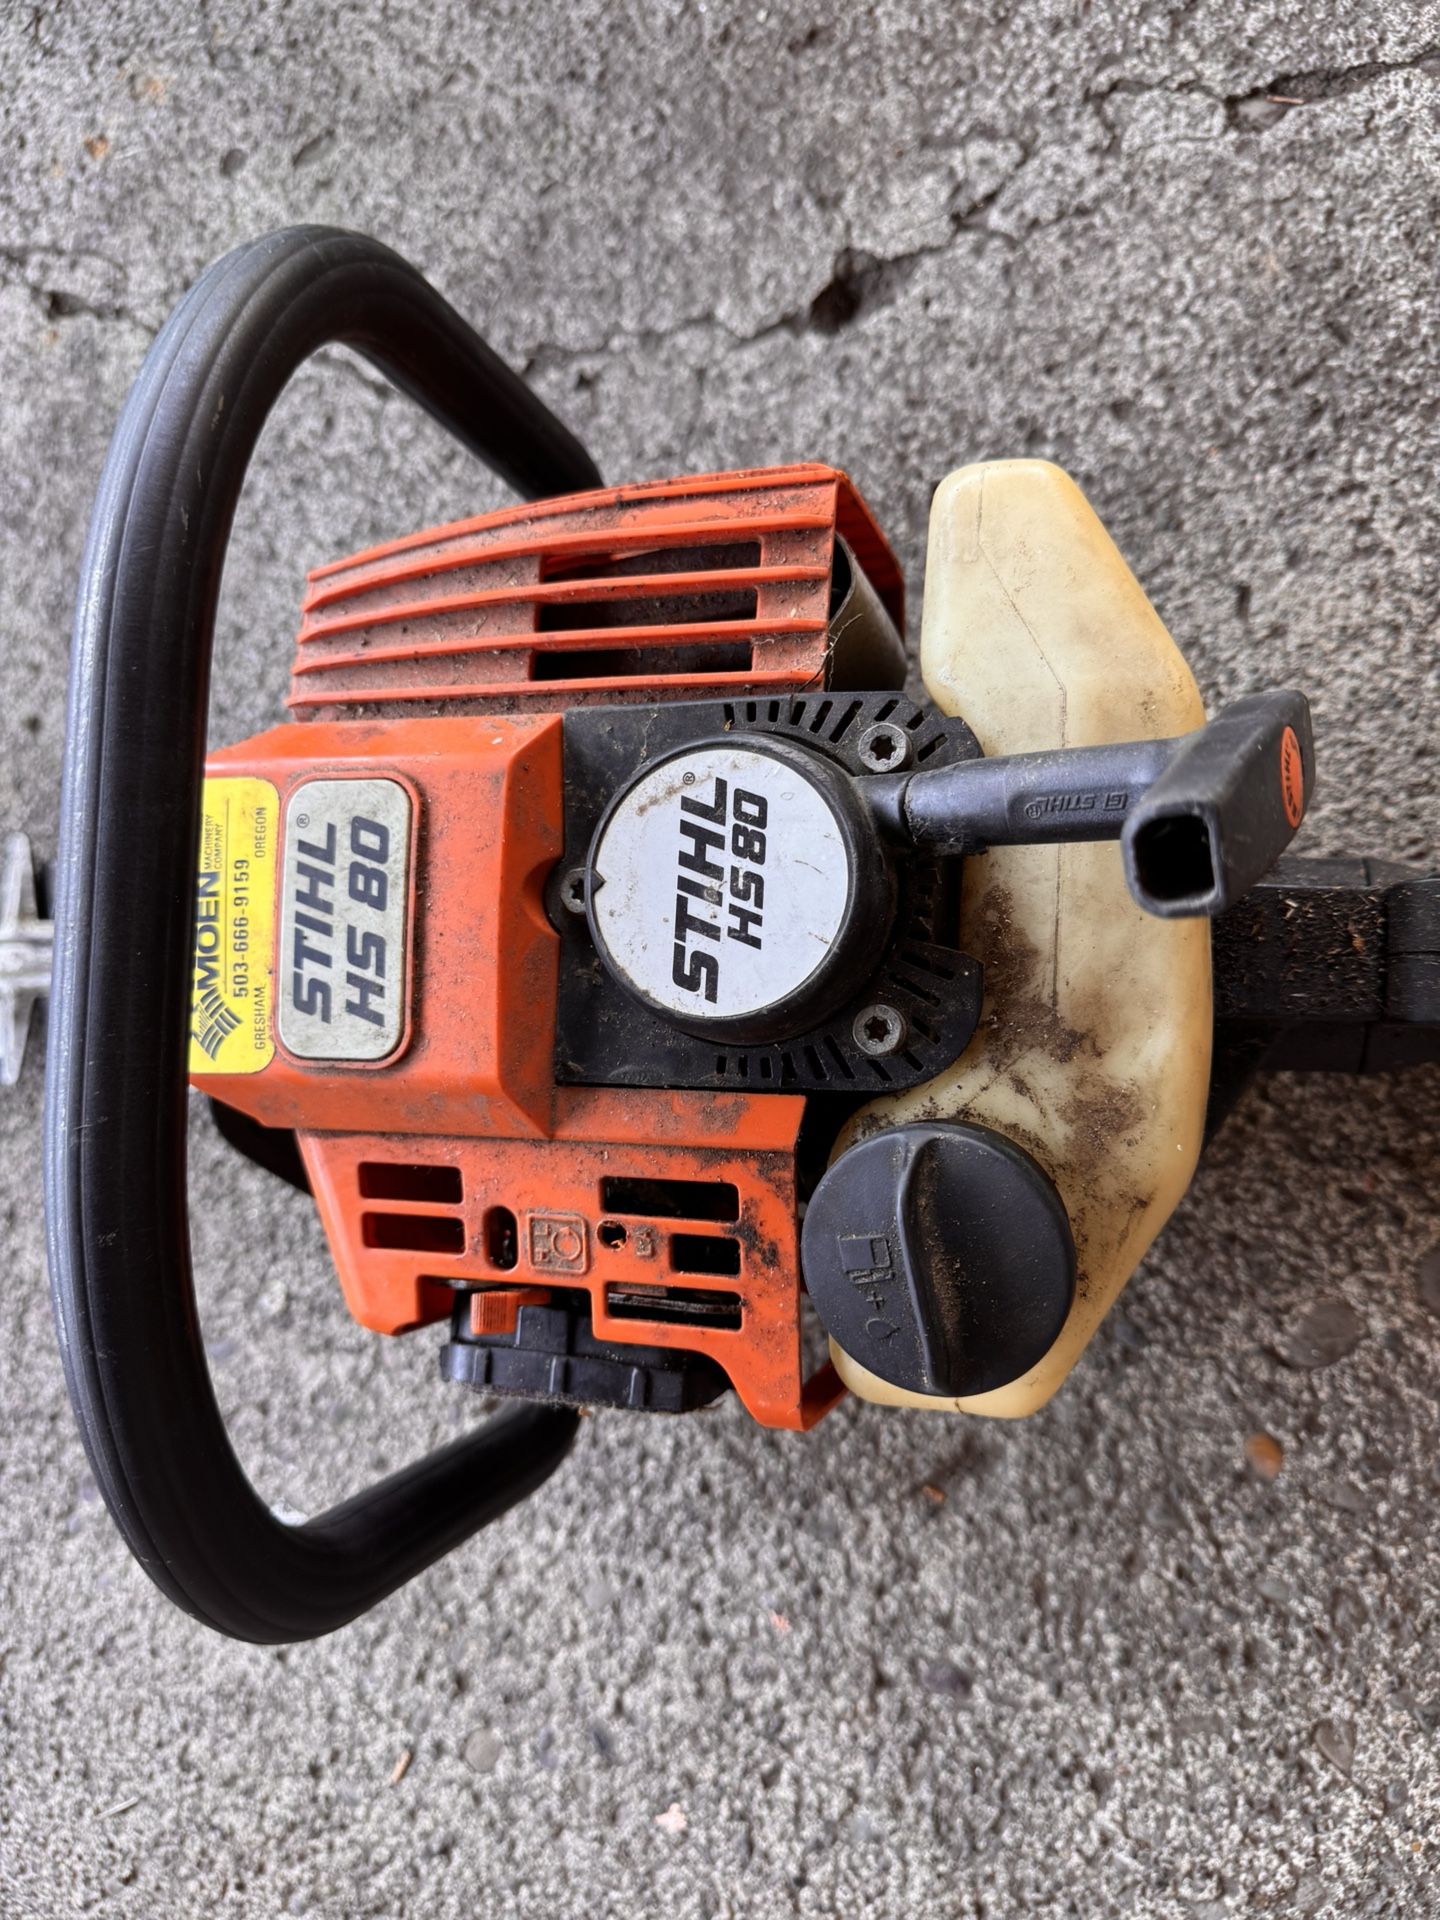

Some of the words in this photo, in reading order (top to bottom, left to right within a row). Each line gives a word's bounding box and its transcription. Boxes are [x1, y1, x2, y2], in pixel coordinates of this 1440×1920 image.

[204, 814, 213, 869] MACHINERY
[214, 823, 222, 869] COMPANY
[254, 806, 266, 858] OREGON
[731, 788, 768, 866] 80
[1025, 792, 1096, 819] STIHL®
[348, 815, 390, 912] 80
[672, 772, 728, 1004] STIHL®
[197, 872, 220, 991] MOEN
[233, 859, 250, 998] 503-666-9159
[293, 813, 337, 1025] STIHL®
[727, 865, 765, 950] HS
[254, 986, 265, 1050] GRESHAM
[345, 924, 386, 1028] HS
